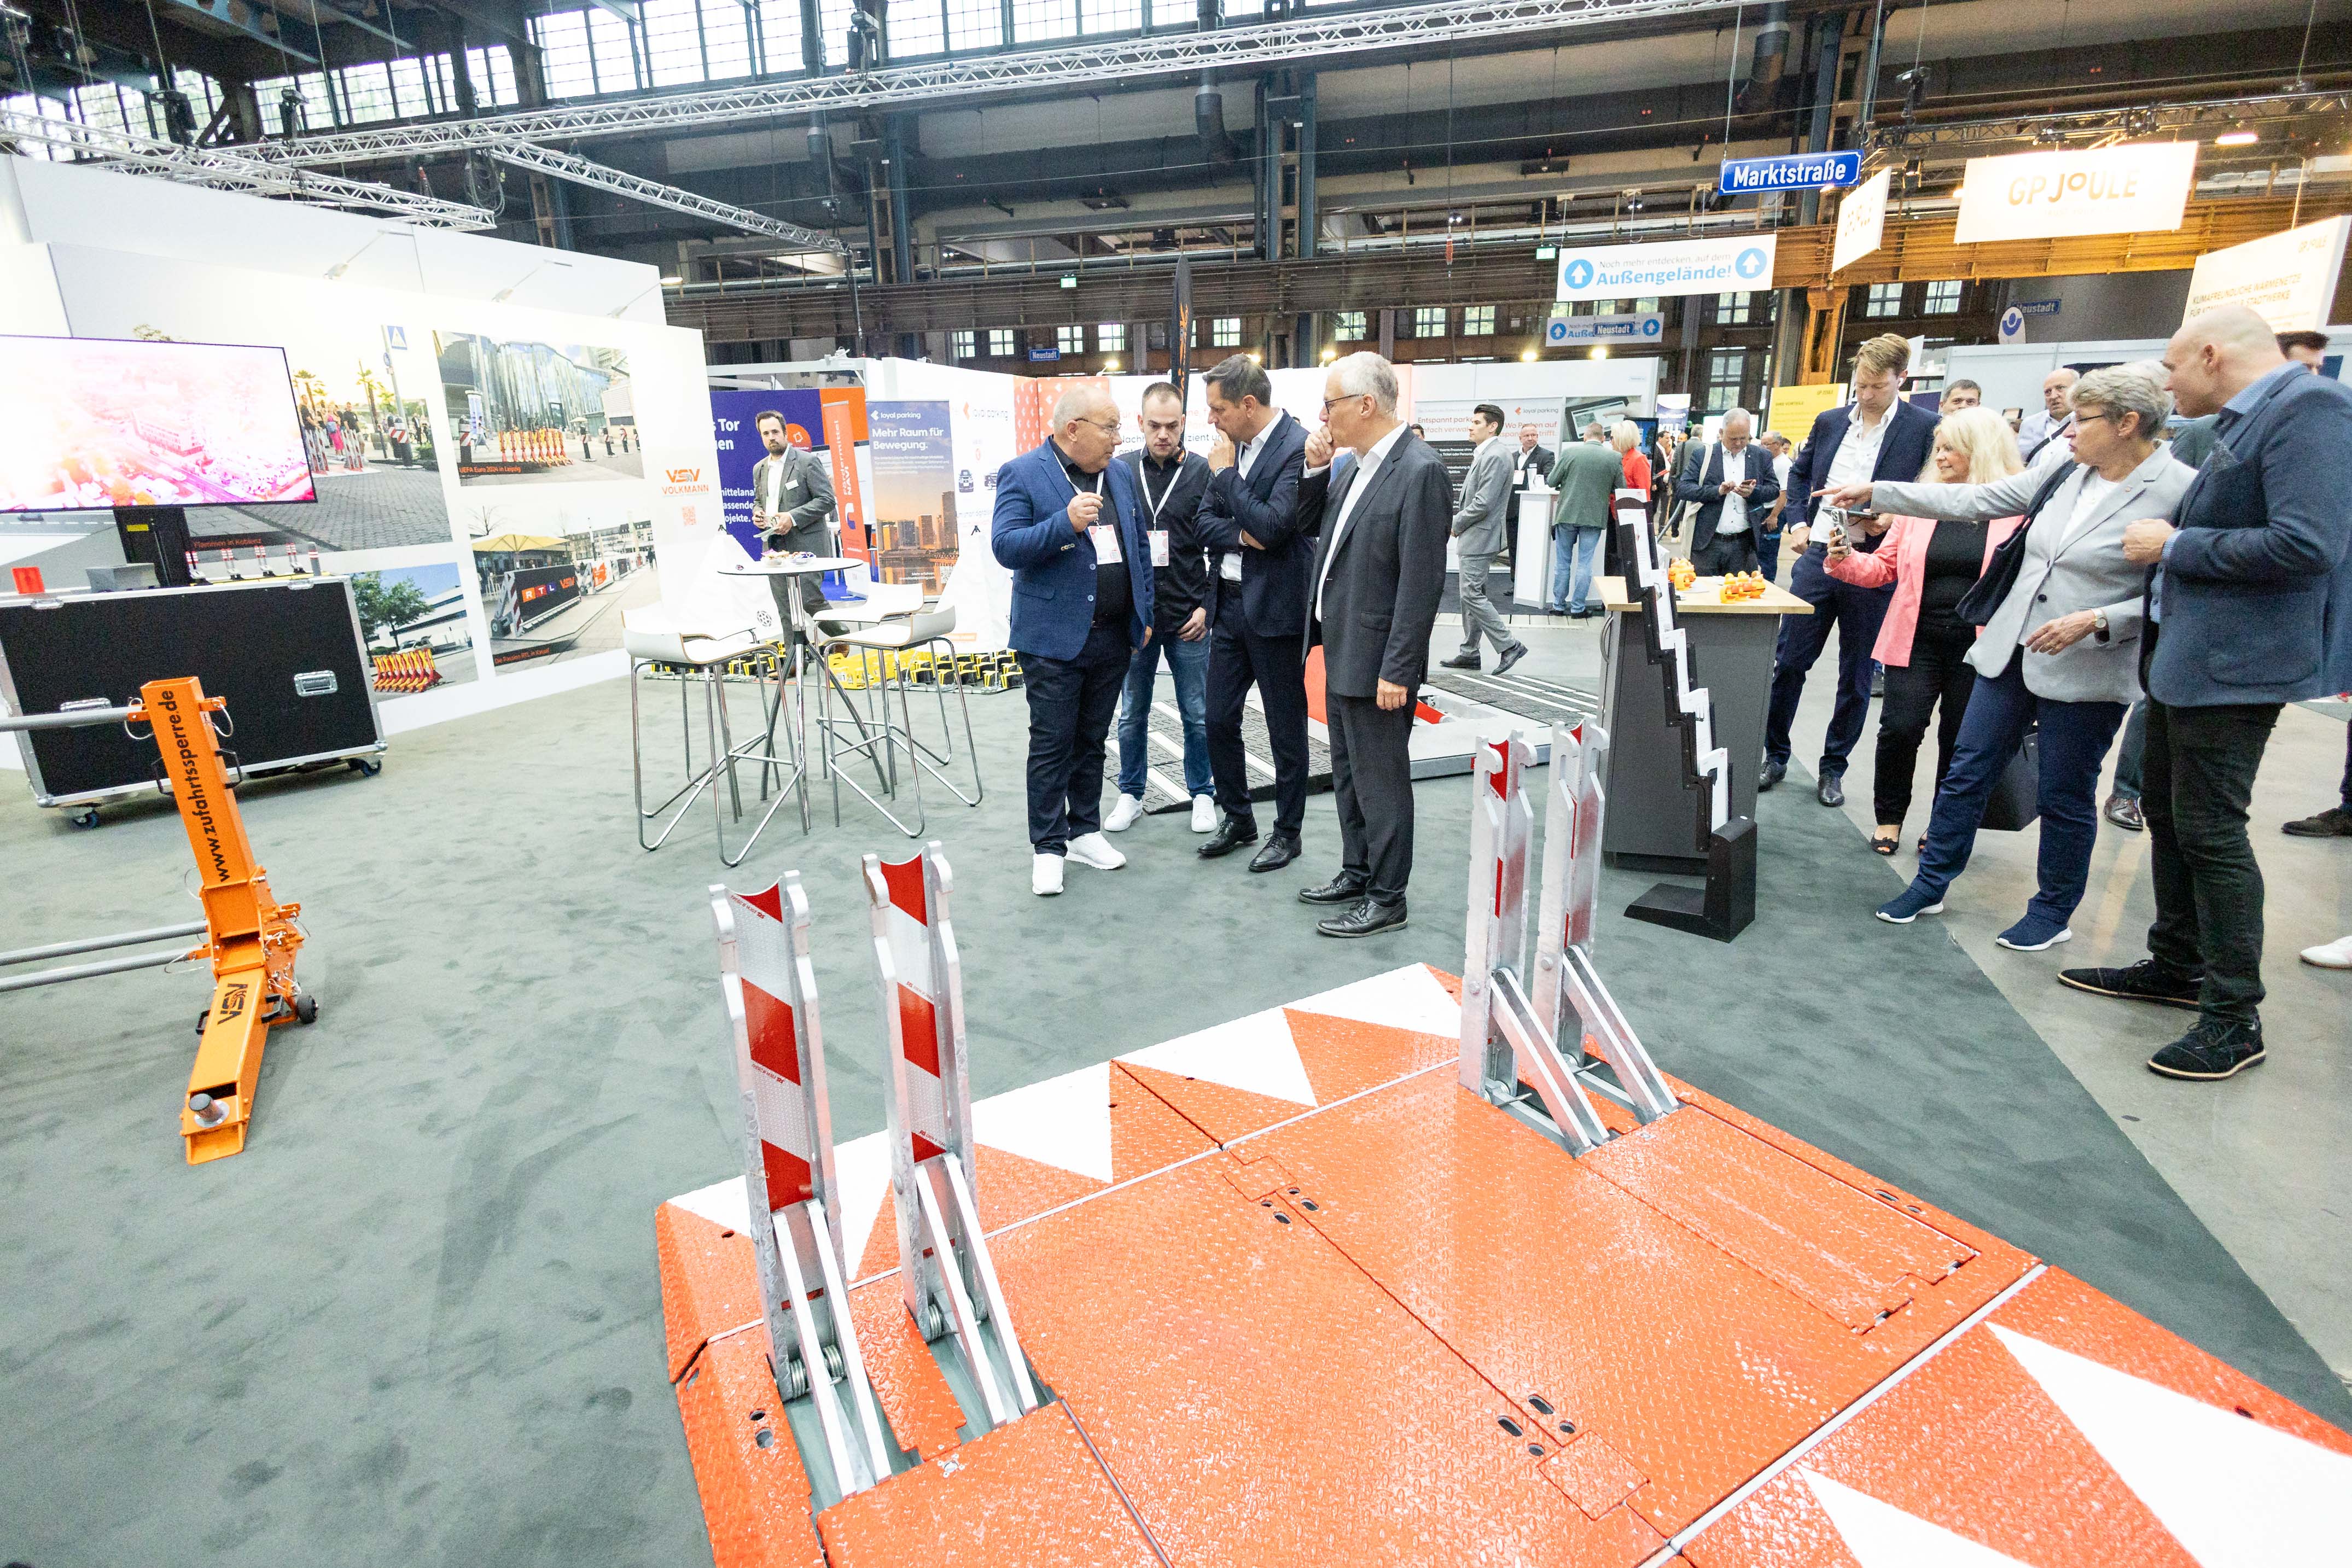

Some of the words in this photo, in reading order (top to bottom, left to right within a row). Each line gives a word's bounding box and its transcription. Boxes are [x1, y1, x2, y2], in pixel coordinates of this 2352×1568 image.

[1733, 159, 1846, 187] Marktstraße
[2008, 175, 2047, 206] GP
[2048, 170, 2139, 203] JOULE
[1599, 260, 1620, 269] Noch
[1623, 259, 1645, 267] mehr
[1695, 254, 1709, 263] auf
[1711, 253, 1731, 261] dem
[1597, 265, 1732, 285] Außengelände!
[1598, 325, 1629, 334] Neustadt
[1033, 351, 1057, 359] Neustadt
[718, 418, 740, 432] Tor
[872, 428, 897, 437] Mehr
[900, 428, 928, 437] Raum
[929, 427, 944, 436] für
[873, 441, 928, 451] Bewegung.
[665, 469, 700, 483] VSV
[844, 467, 852, 496] NAVI
[661, 485, 708, 494] VOLKMANN
[524, 583, 556, 601] RTL
[158, 690, 230, 884] www.zufahrtssperre.de
[218, 983, 248, 1026] VSV
